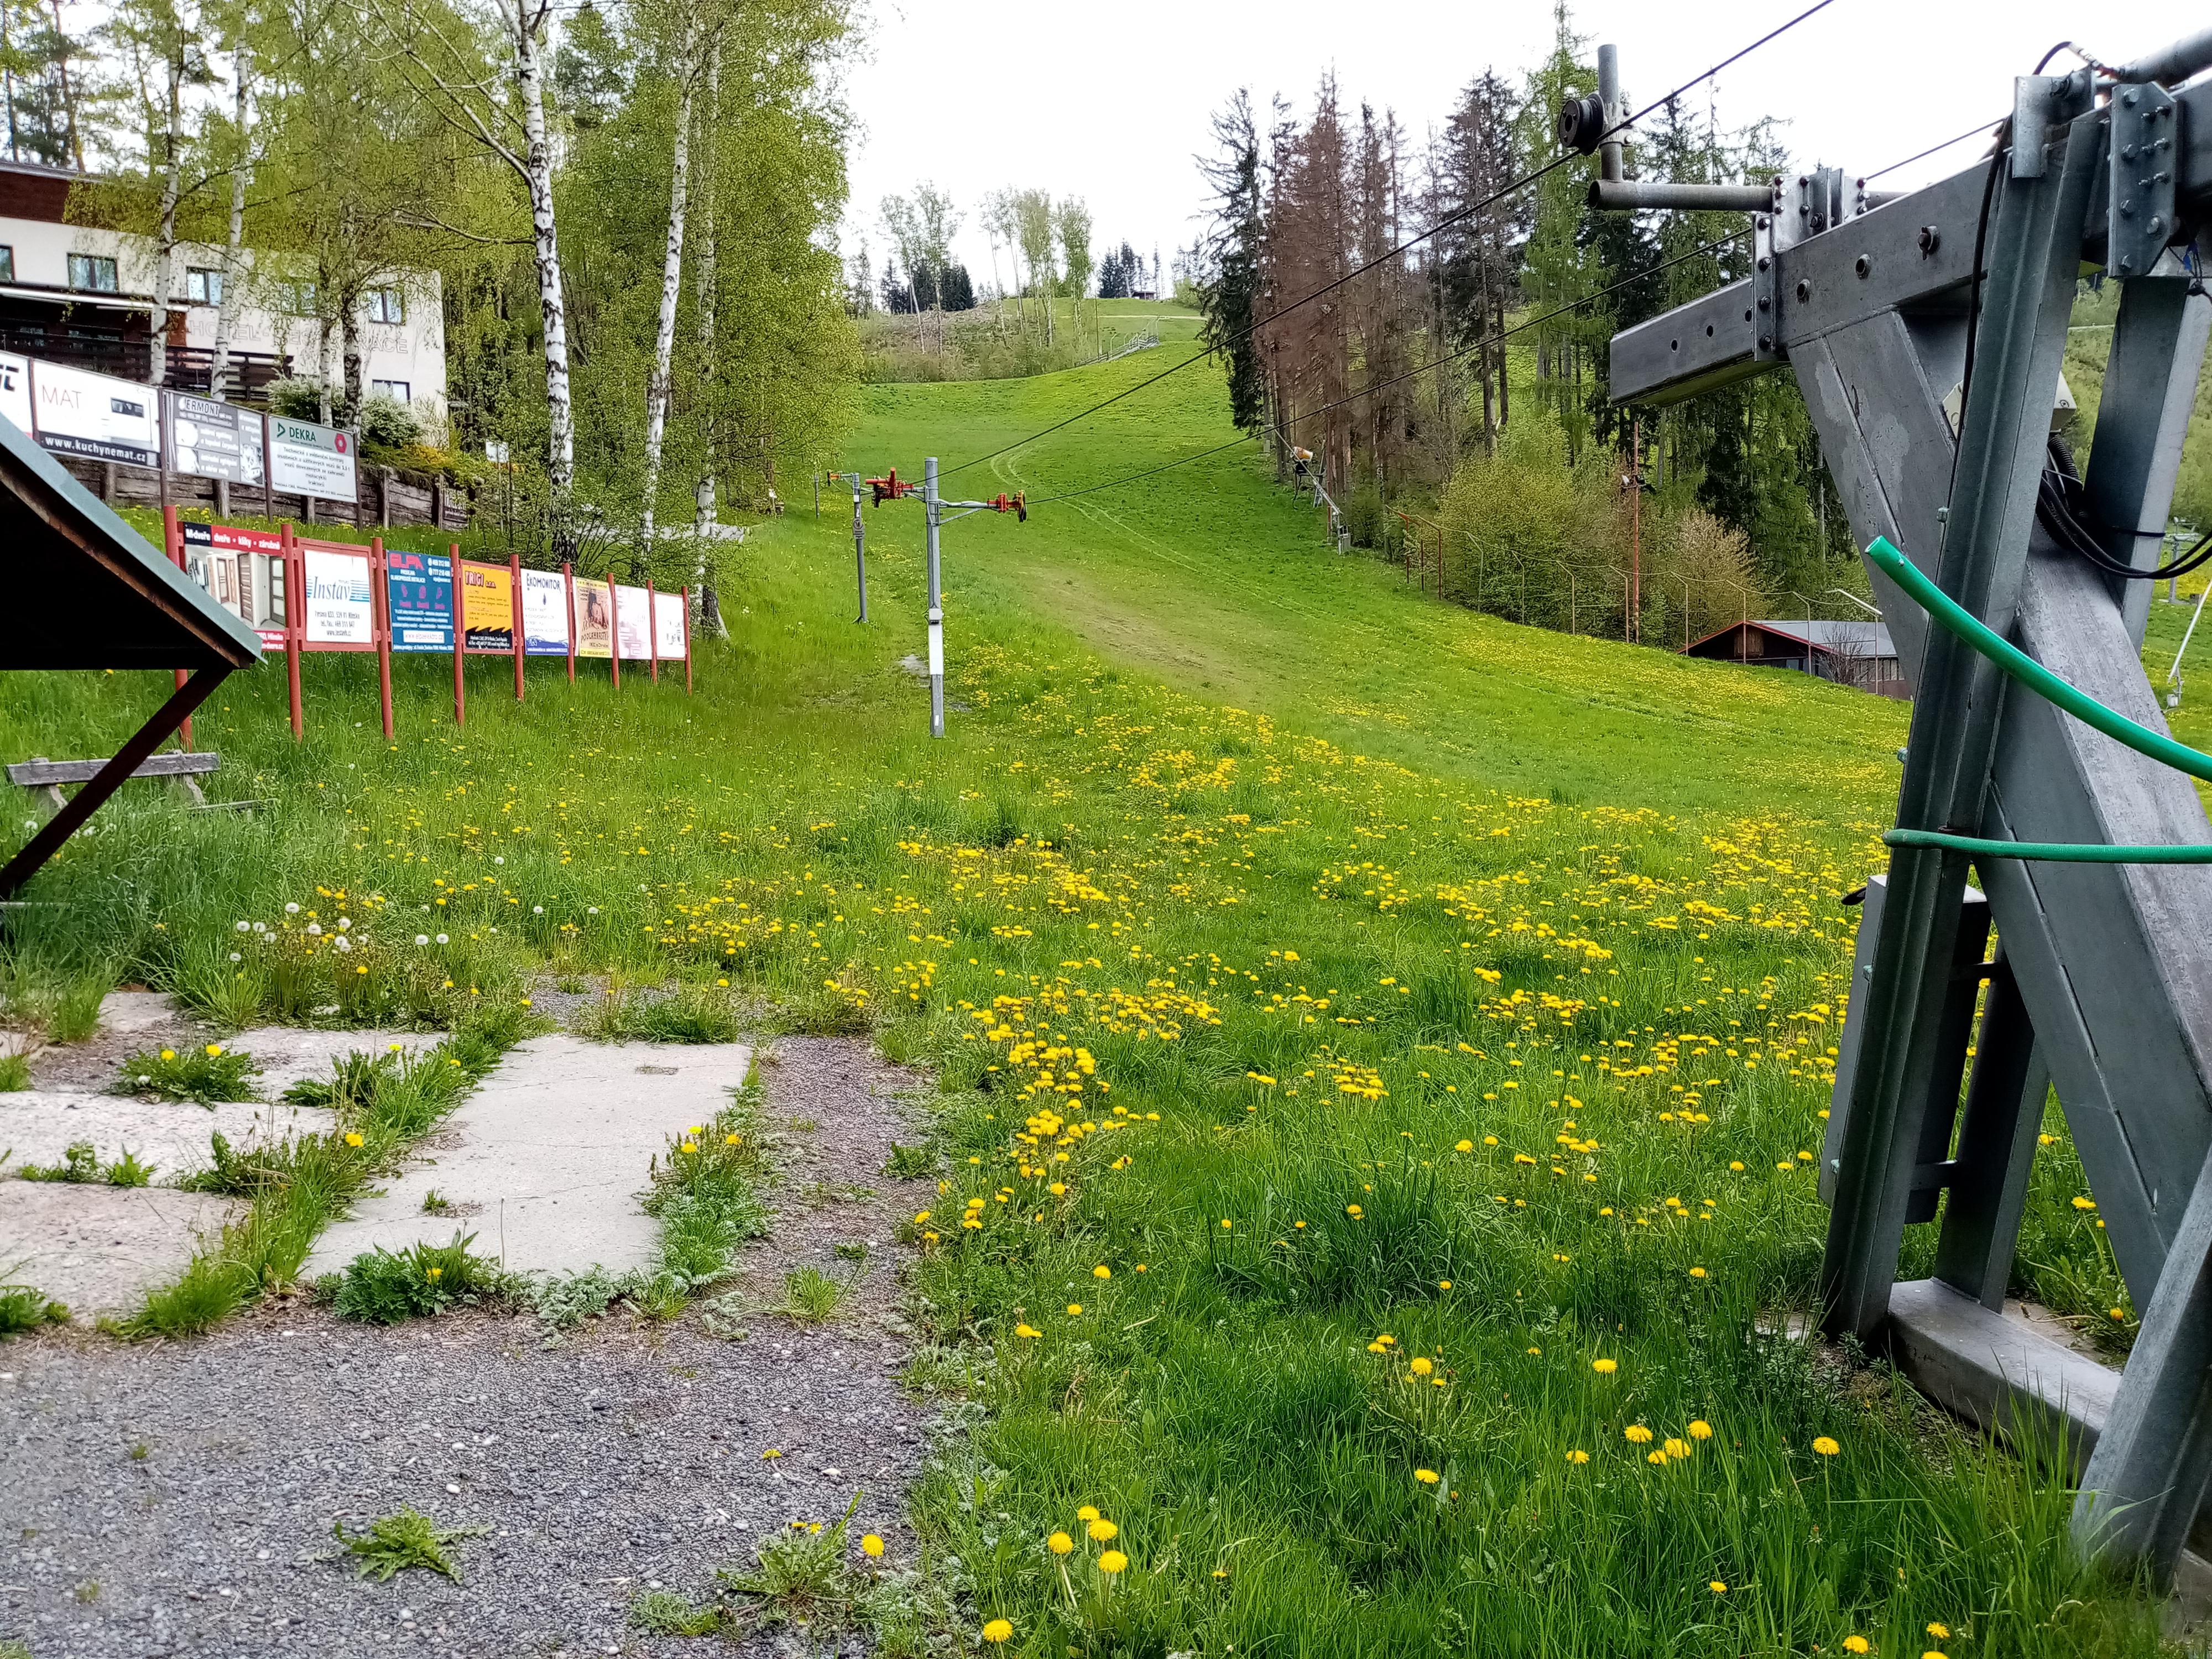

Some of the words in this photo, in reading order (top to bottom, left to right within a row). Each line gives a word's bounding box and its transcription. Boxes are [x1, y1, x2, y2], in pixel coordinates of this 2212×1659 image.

[42, 385, 82, 409] MAT
[186, 399, 220, 415] ERMONT
[289, 426, 316, 442] DEKRA
[45, 436, 147, 463] www.kuchynemat.cz
[186, 529, 211, 540] M-dveře
[213, 533, 230, 544] dveře
[389, 554, 424, 571] ELPA
[465, 570, 484, 587] TRIGI
[526, 573, 561, 592] EKOMONITOR
[313, 576, 351, 600] Instav
